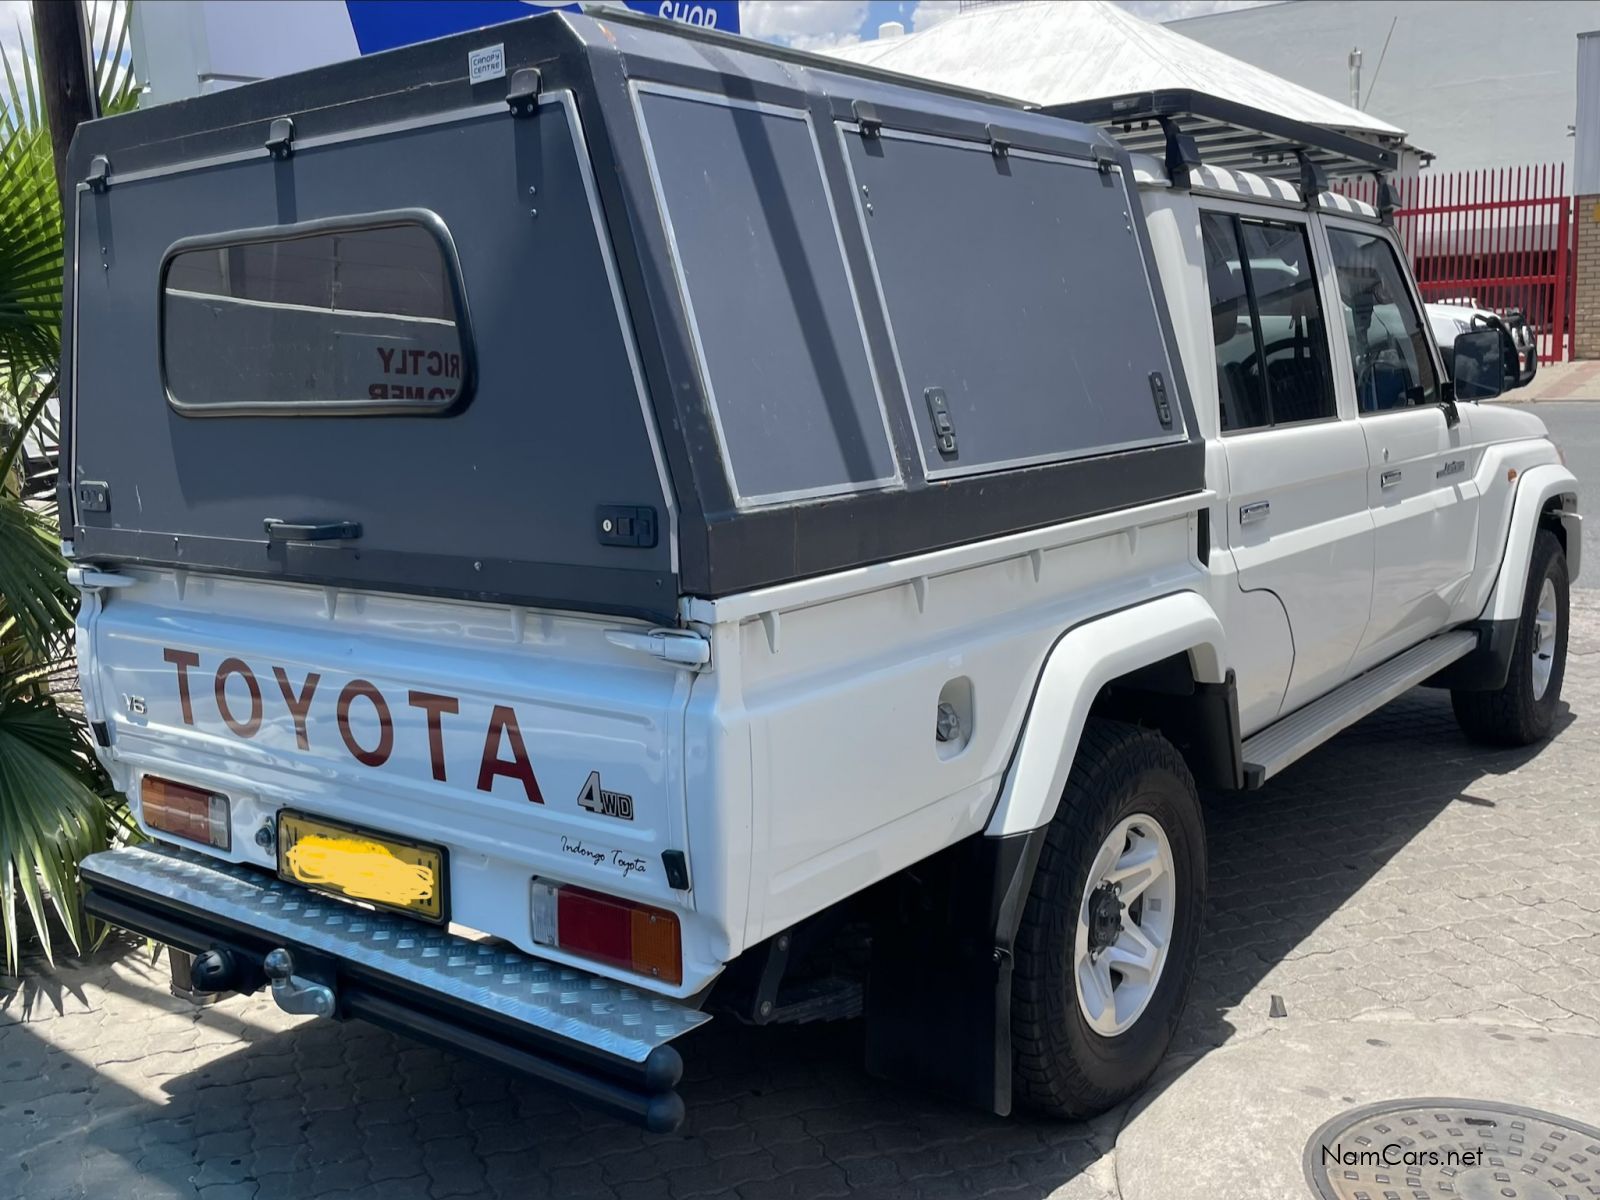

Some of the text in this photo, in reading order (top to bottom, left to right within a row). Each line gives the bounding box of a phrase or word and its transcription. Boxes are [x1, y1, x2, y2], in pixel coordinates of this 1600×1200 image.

[659, 1, 717, 29] SHOP
[473, 53, 500, 66] CANOPY
[473, 61, 500, 75] CENTRE
[163, 647, 545, 805] TOYOTA
[577, 770, 634, 821] 4WD
[560, 835, 647, 878] Indongo Toyota
